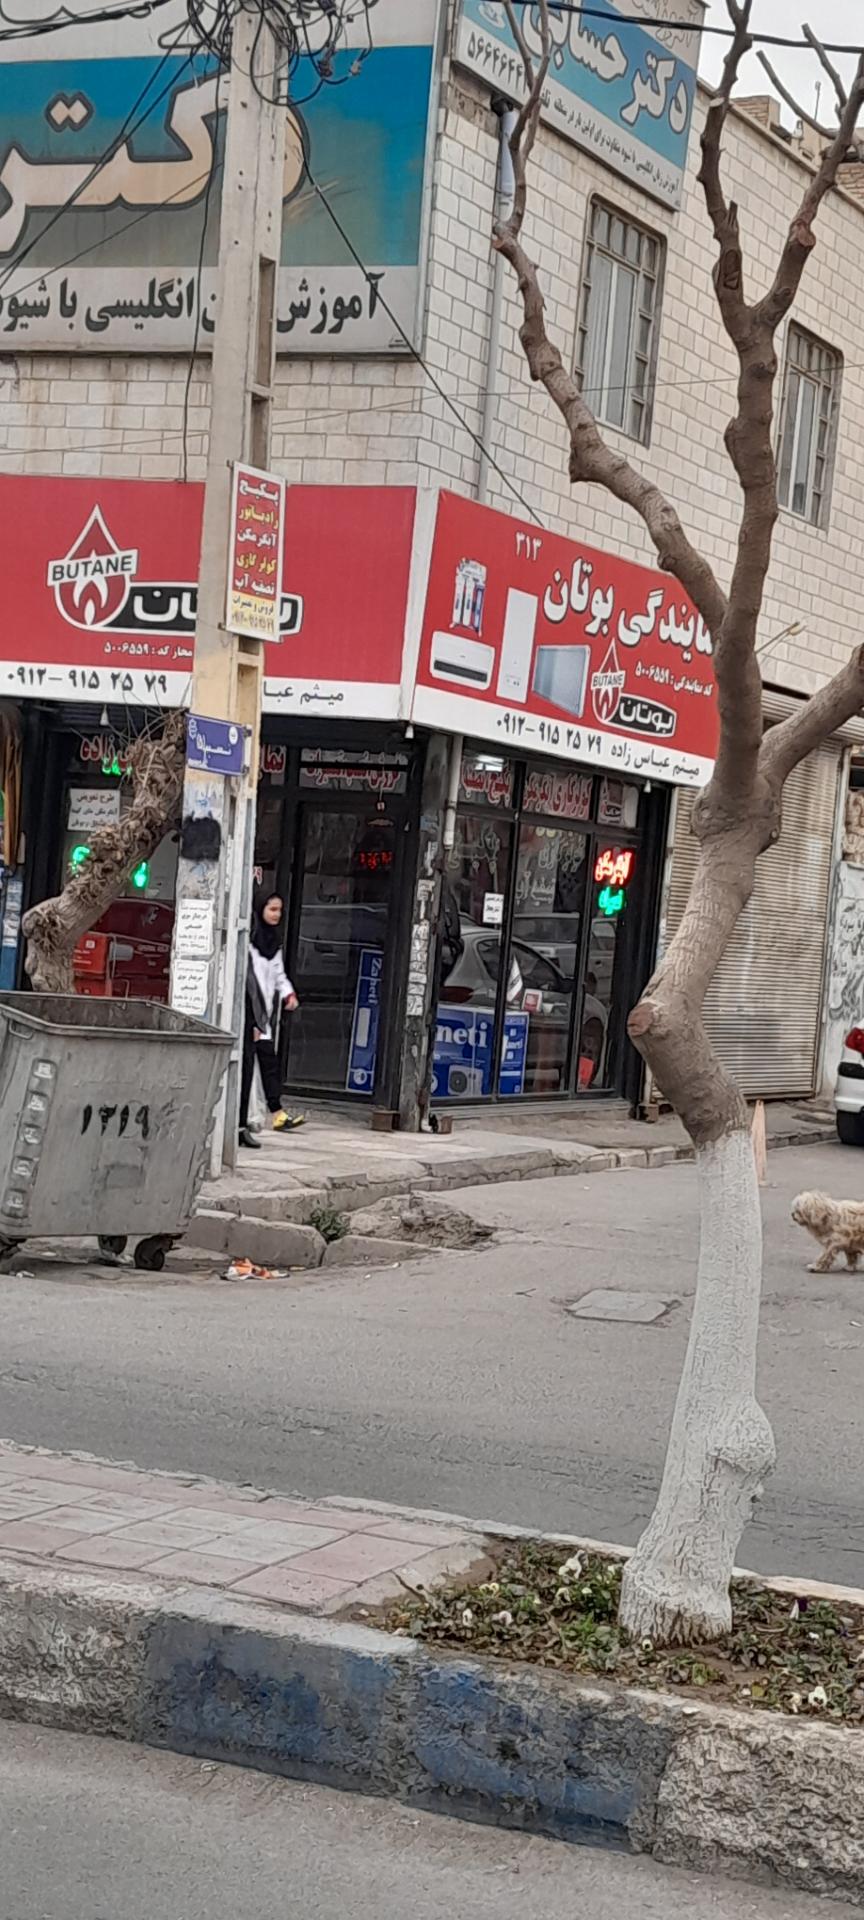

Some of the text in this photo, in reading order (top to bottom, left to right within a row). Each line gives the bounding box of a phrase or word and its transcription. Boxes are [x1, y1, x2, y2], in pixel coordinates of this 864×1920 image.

[620, 50, 689, 134] دکتر
[0, 279, 50, 334] شیو
[58, 278, 78, 332] با
[85, 276, 194, 333] انگلیسی
[239, 479, 279, 506] پکیج
[238, 504, 279, 530] رادیاتور
[515, 531, 542, 561] ۳۱۳
[52, 555, 133, 582] BUTANE
[236, 552, 277, 574] کولر گازی
[235, 573, 275, 596] تصفیه آب
[543, 557, 614, 638] بوتان
[110, 671, 134, 693] ۲۵
[144, 675, 167, 695] ۷۹
[263, 680, 344, 706] میثم عبا
[592, 672, 625, 687] BUTANE
[619, 699, 674, 731] بوتان
[566, 729, 581, 749] ۲۵
[587, 734, 602, 752] ۷۹
[611, 743, 700, 777] میثم عباس زاده
[436, 1021, 488, 1049] neti
